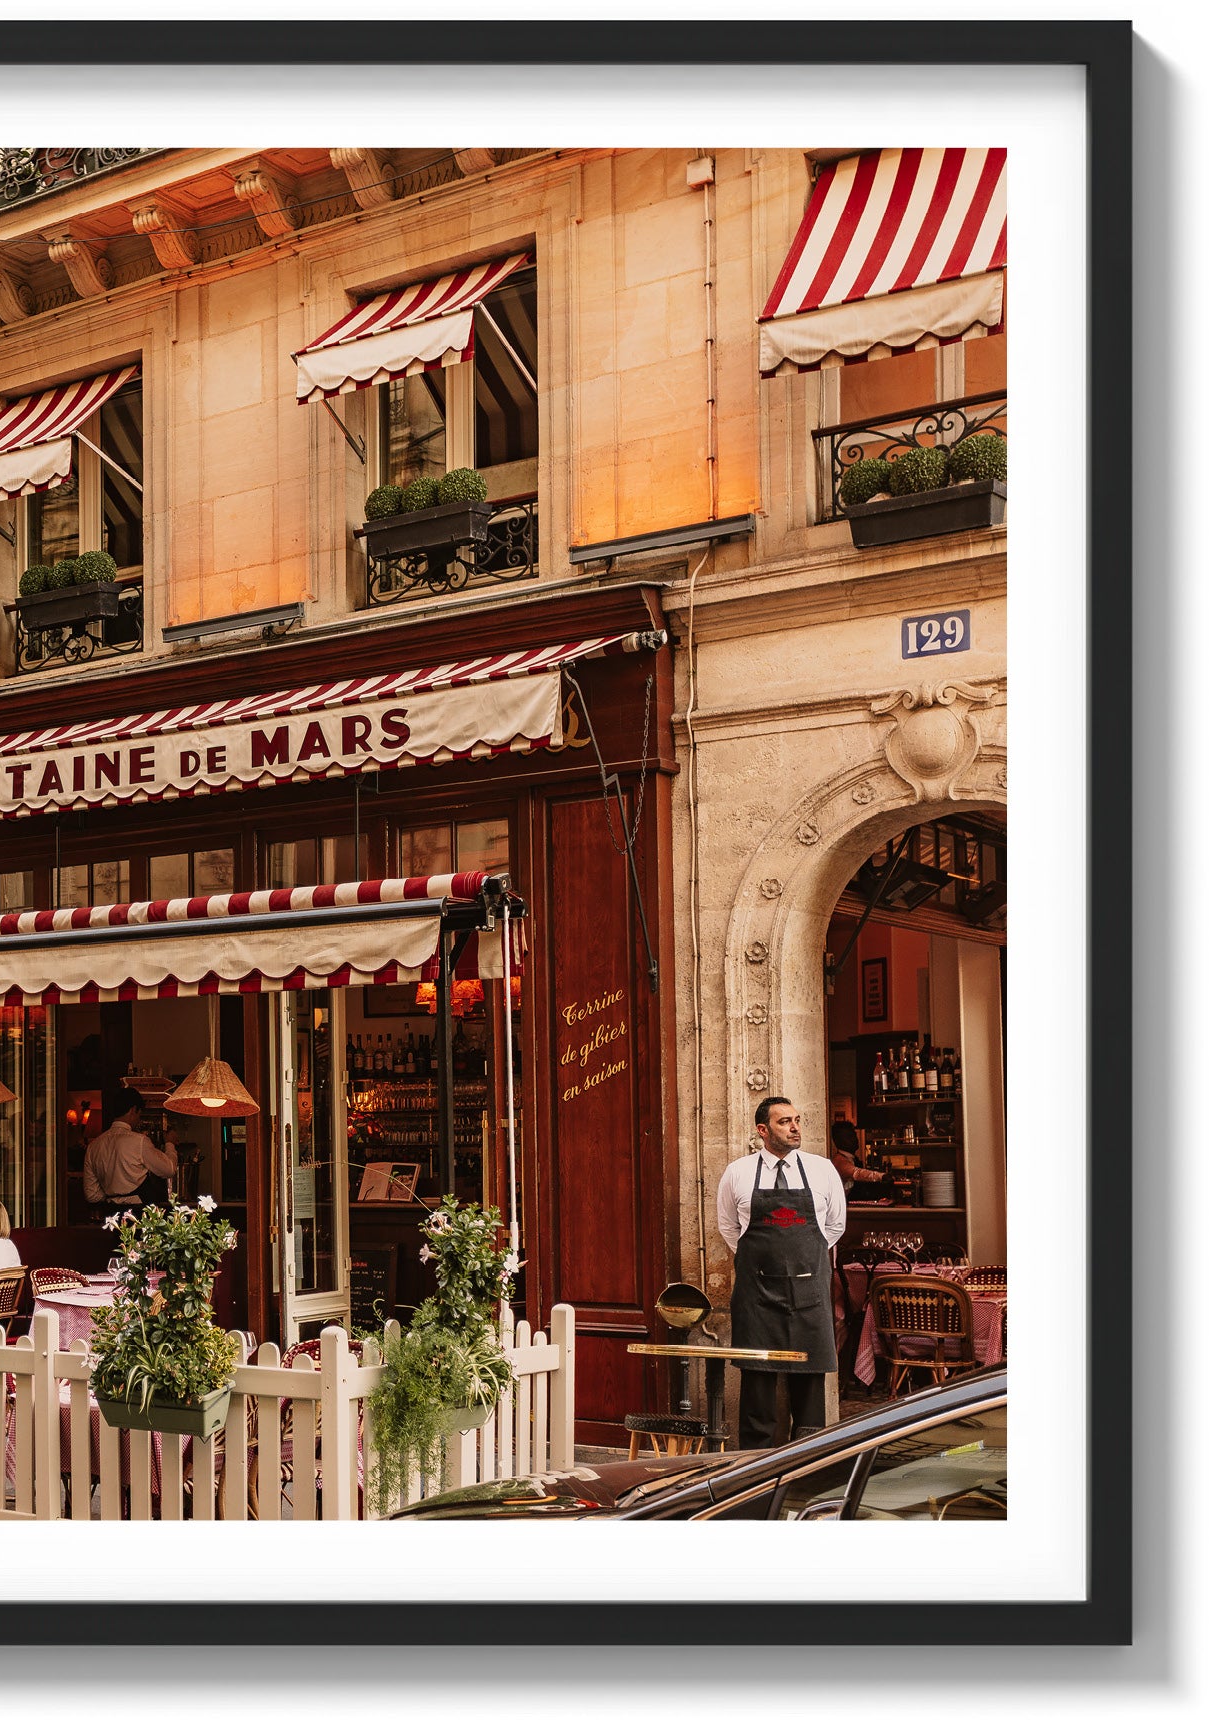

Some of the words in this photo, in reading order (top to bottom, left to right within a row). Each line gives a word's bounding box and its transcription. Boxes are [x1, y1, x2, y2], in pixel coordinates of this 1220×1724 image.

[907, 616, 964, 654] 129
[180, 746, 227, 778] DE
[251, 708, 411, 768] MARS
[562, 989, 625, 1026] Terrine
[561, 1044, 578, 1066] de
[579, 1020, 628, 1068] gibier
[562, 1084, 582, 1102] en
[583, 1060, 628, 1091] saison
